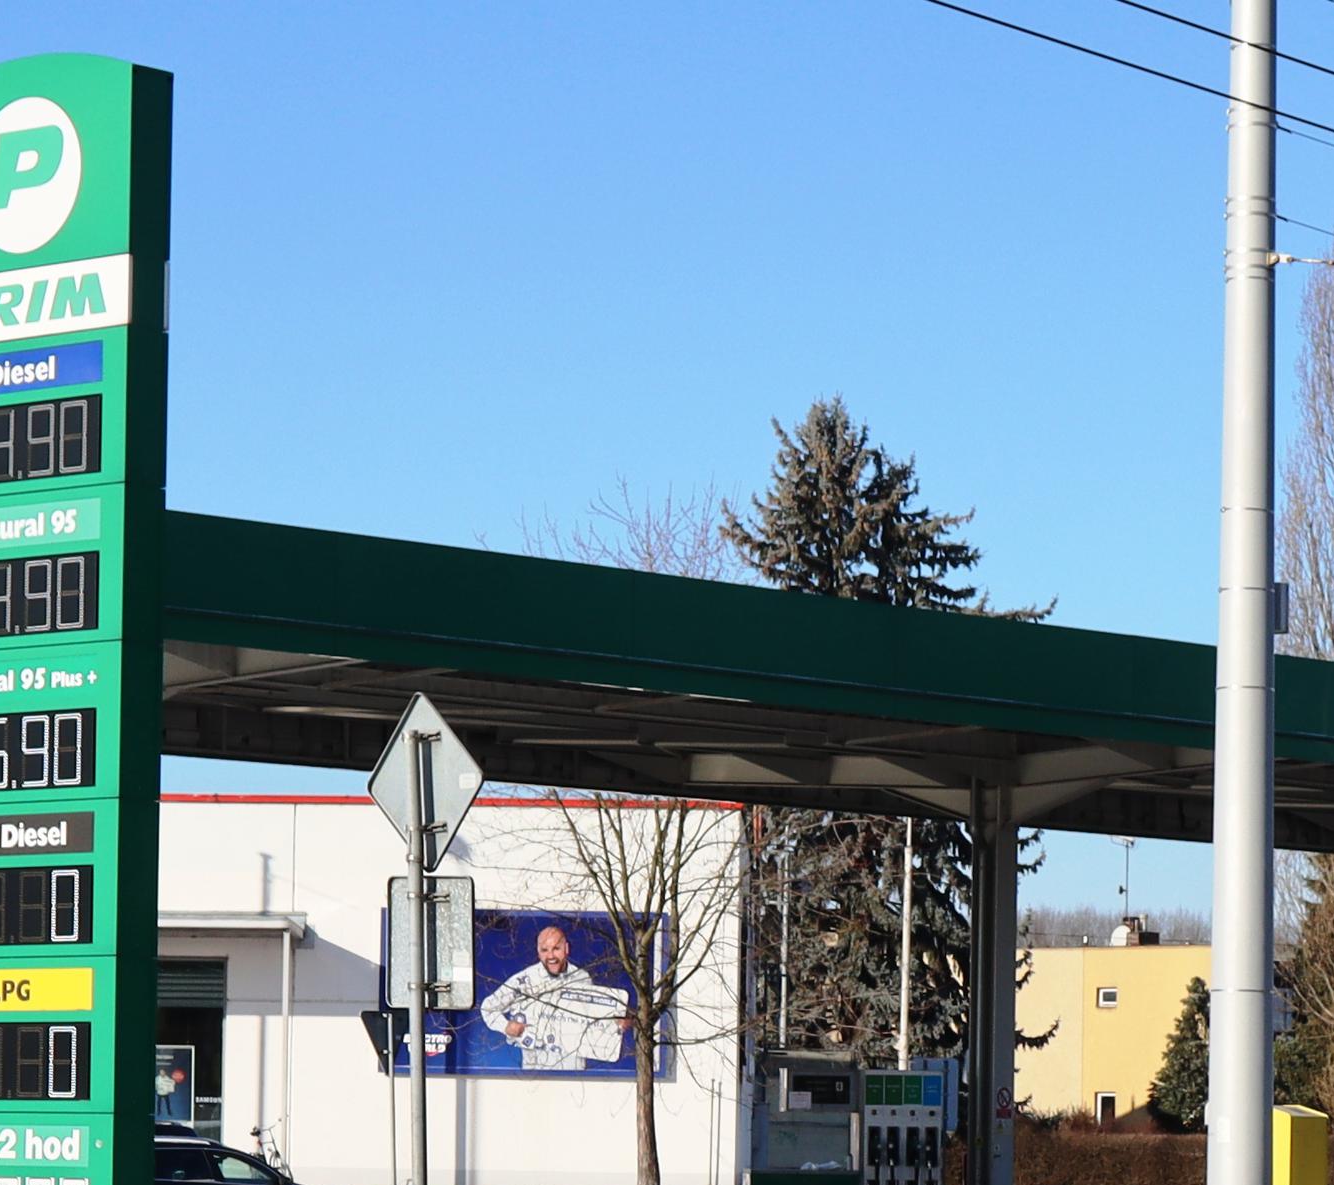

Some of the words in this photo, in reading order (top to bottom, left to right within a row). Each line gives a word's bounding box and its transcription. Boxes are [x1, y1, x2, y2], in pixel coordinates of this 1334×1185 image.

[50, 508, 77, 536] 95
[20, 667, 46, 690] 95
[50, 670, 84, 689] Plus
[0, 820, 68, 849] Diesel
[24, 1128, 81, 1161] hod
